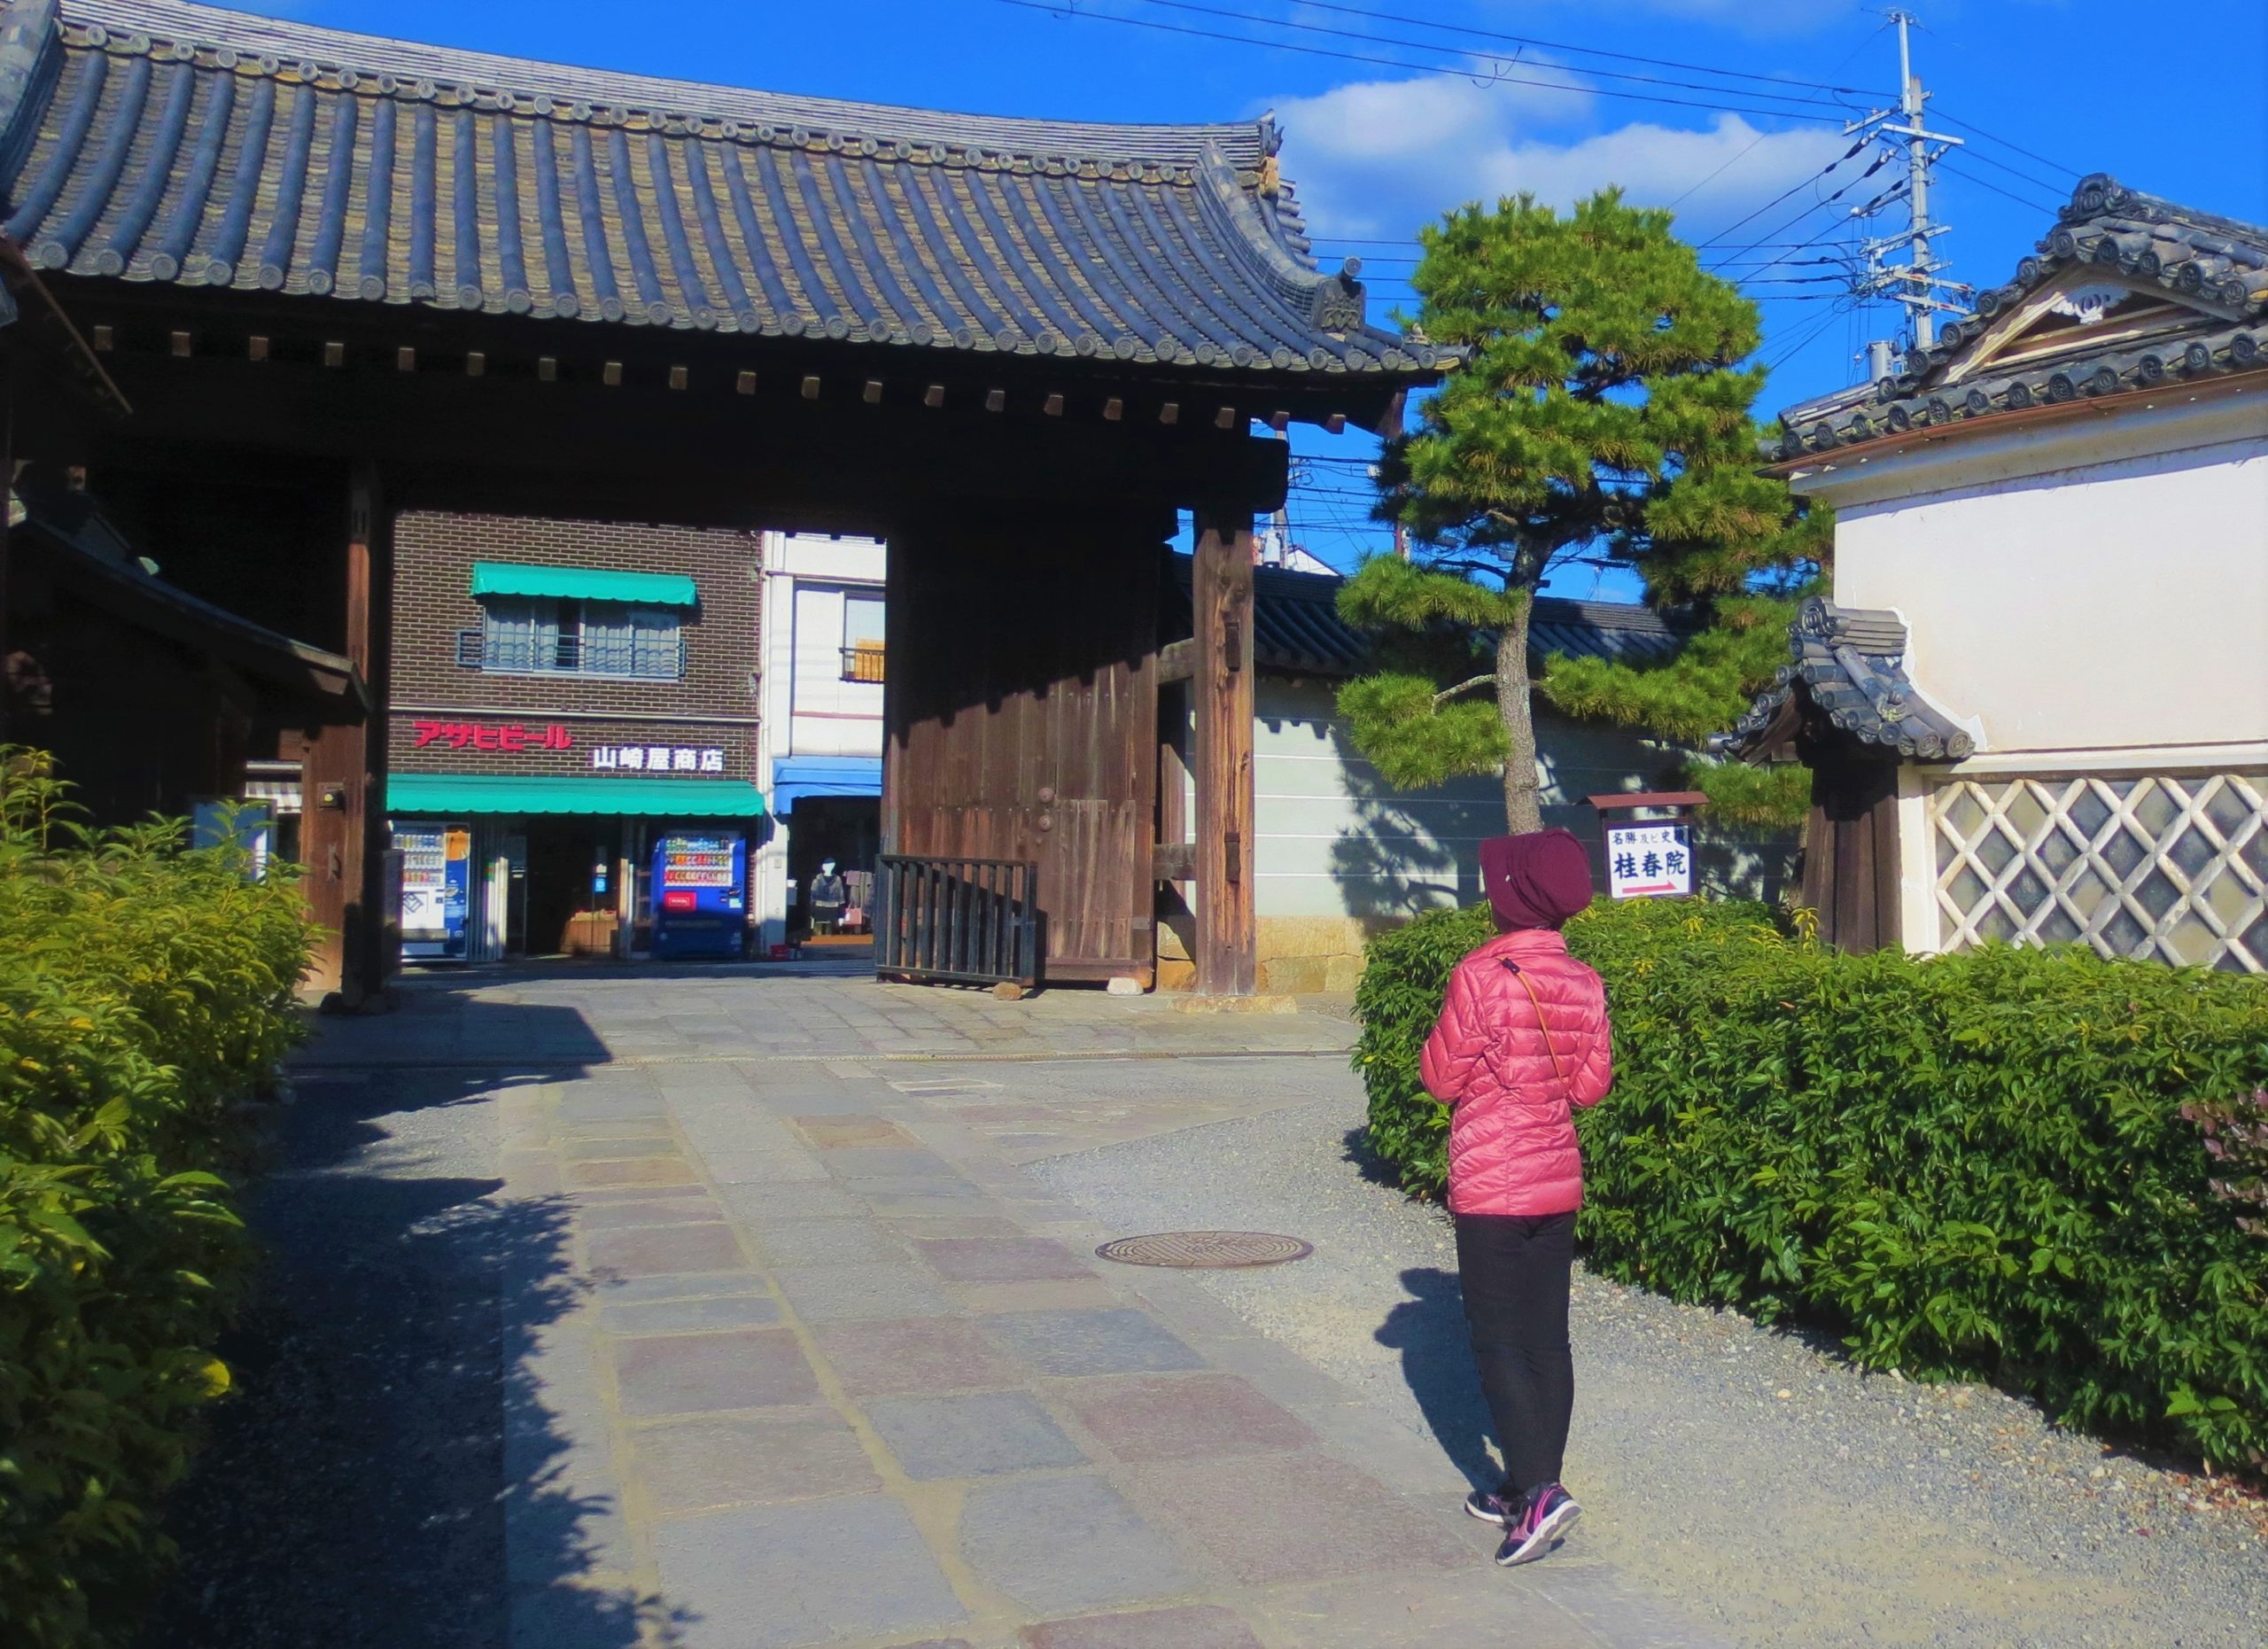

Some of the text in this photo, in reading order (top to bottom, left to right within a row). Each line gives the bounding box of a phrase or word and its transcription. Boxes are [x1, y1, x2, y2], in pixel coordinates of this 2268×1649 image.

[413, 720, 572, 751] アサヒビール
[593, 746, 725, 772] 山崎屋商店
[1613, 851, 1686, 879] 桂春院
